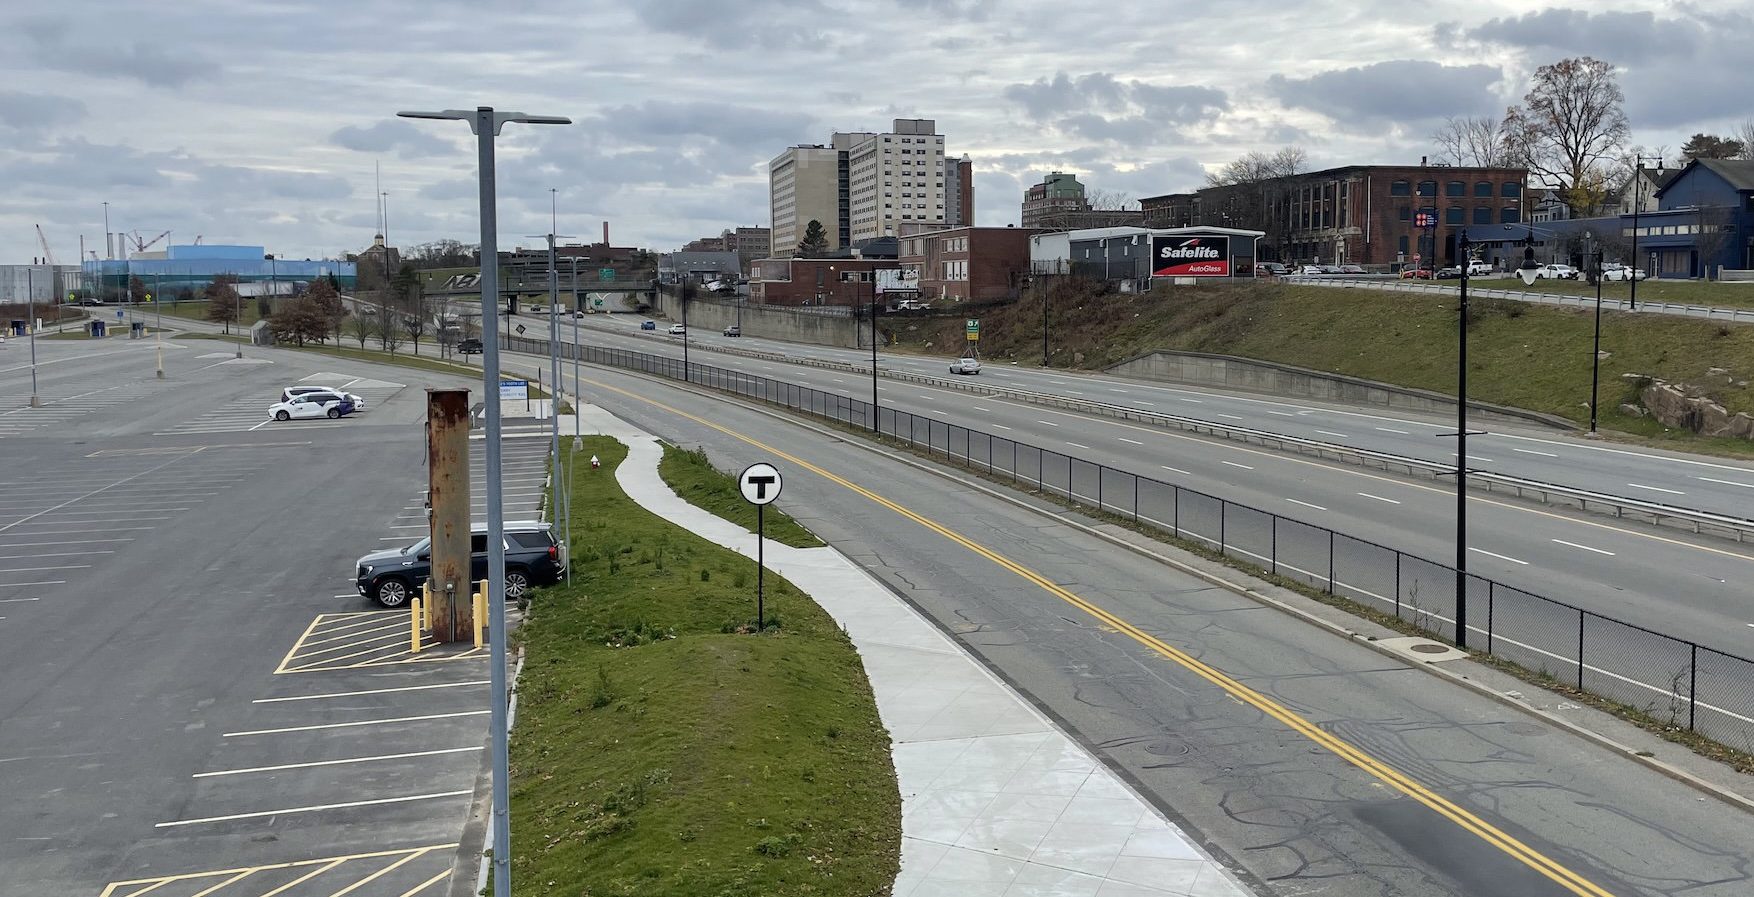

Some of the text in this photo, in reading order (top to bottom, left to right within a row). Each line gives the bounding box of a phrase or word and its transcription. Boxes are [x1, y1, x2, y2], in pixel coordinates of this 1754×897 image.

[1160, 246, 1219, 258] Safelite
[1188, 265, 1221, 273] AutoGlass
[748, 475, 775, 500] T
